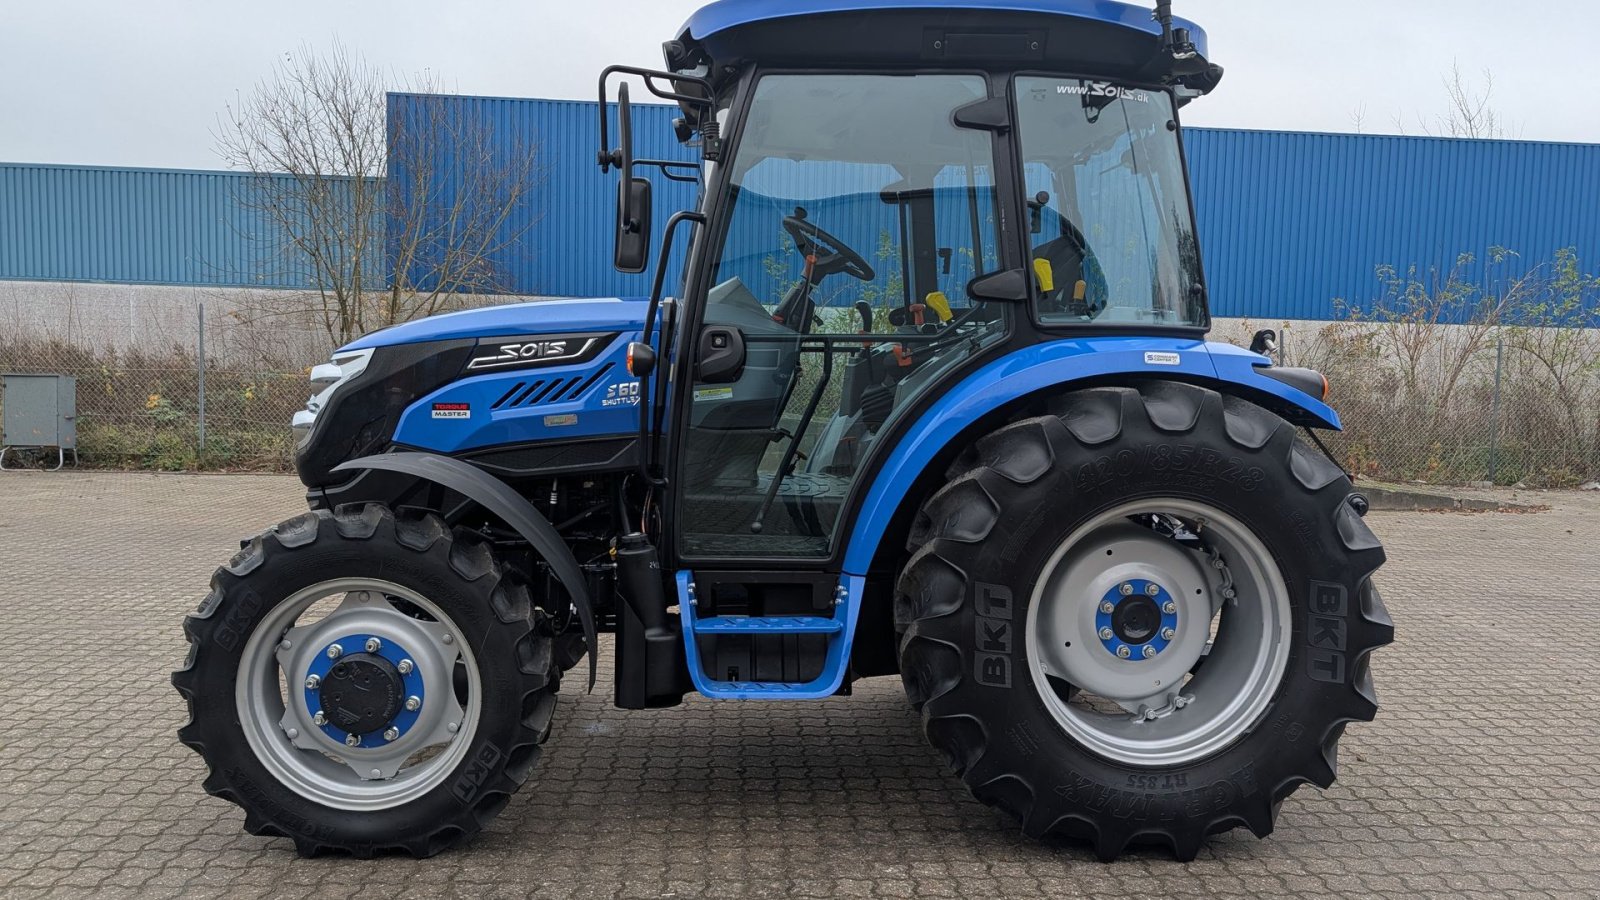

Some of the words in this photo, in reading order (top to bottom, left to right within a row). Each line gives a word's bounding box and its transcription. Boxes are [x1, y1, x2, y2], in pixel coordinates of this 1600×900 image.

[974, 582, 1013, 688] BKT
[1307, 580, 1348, 684] BKT
[453, 740, 501, 803] BKT
